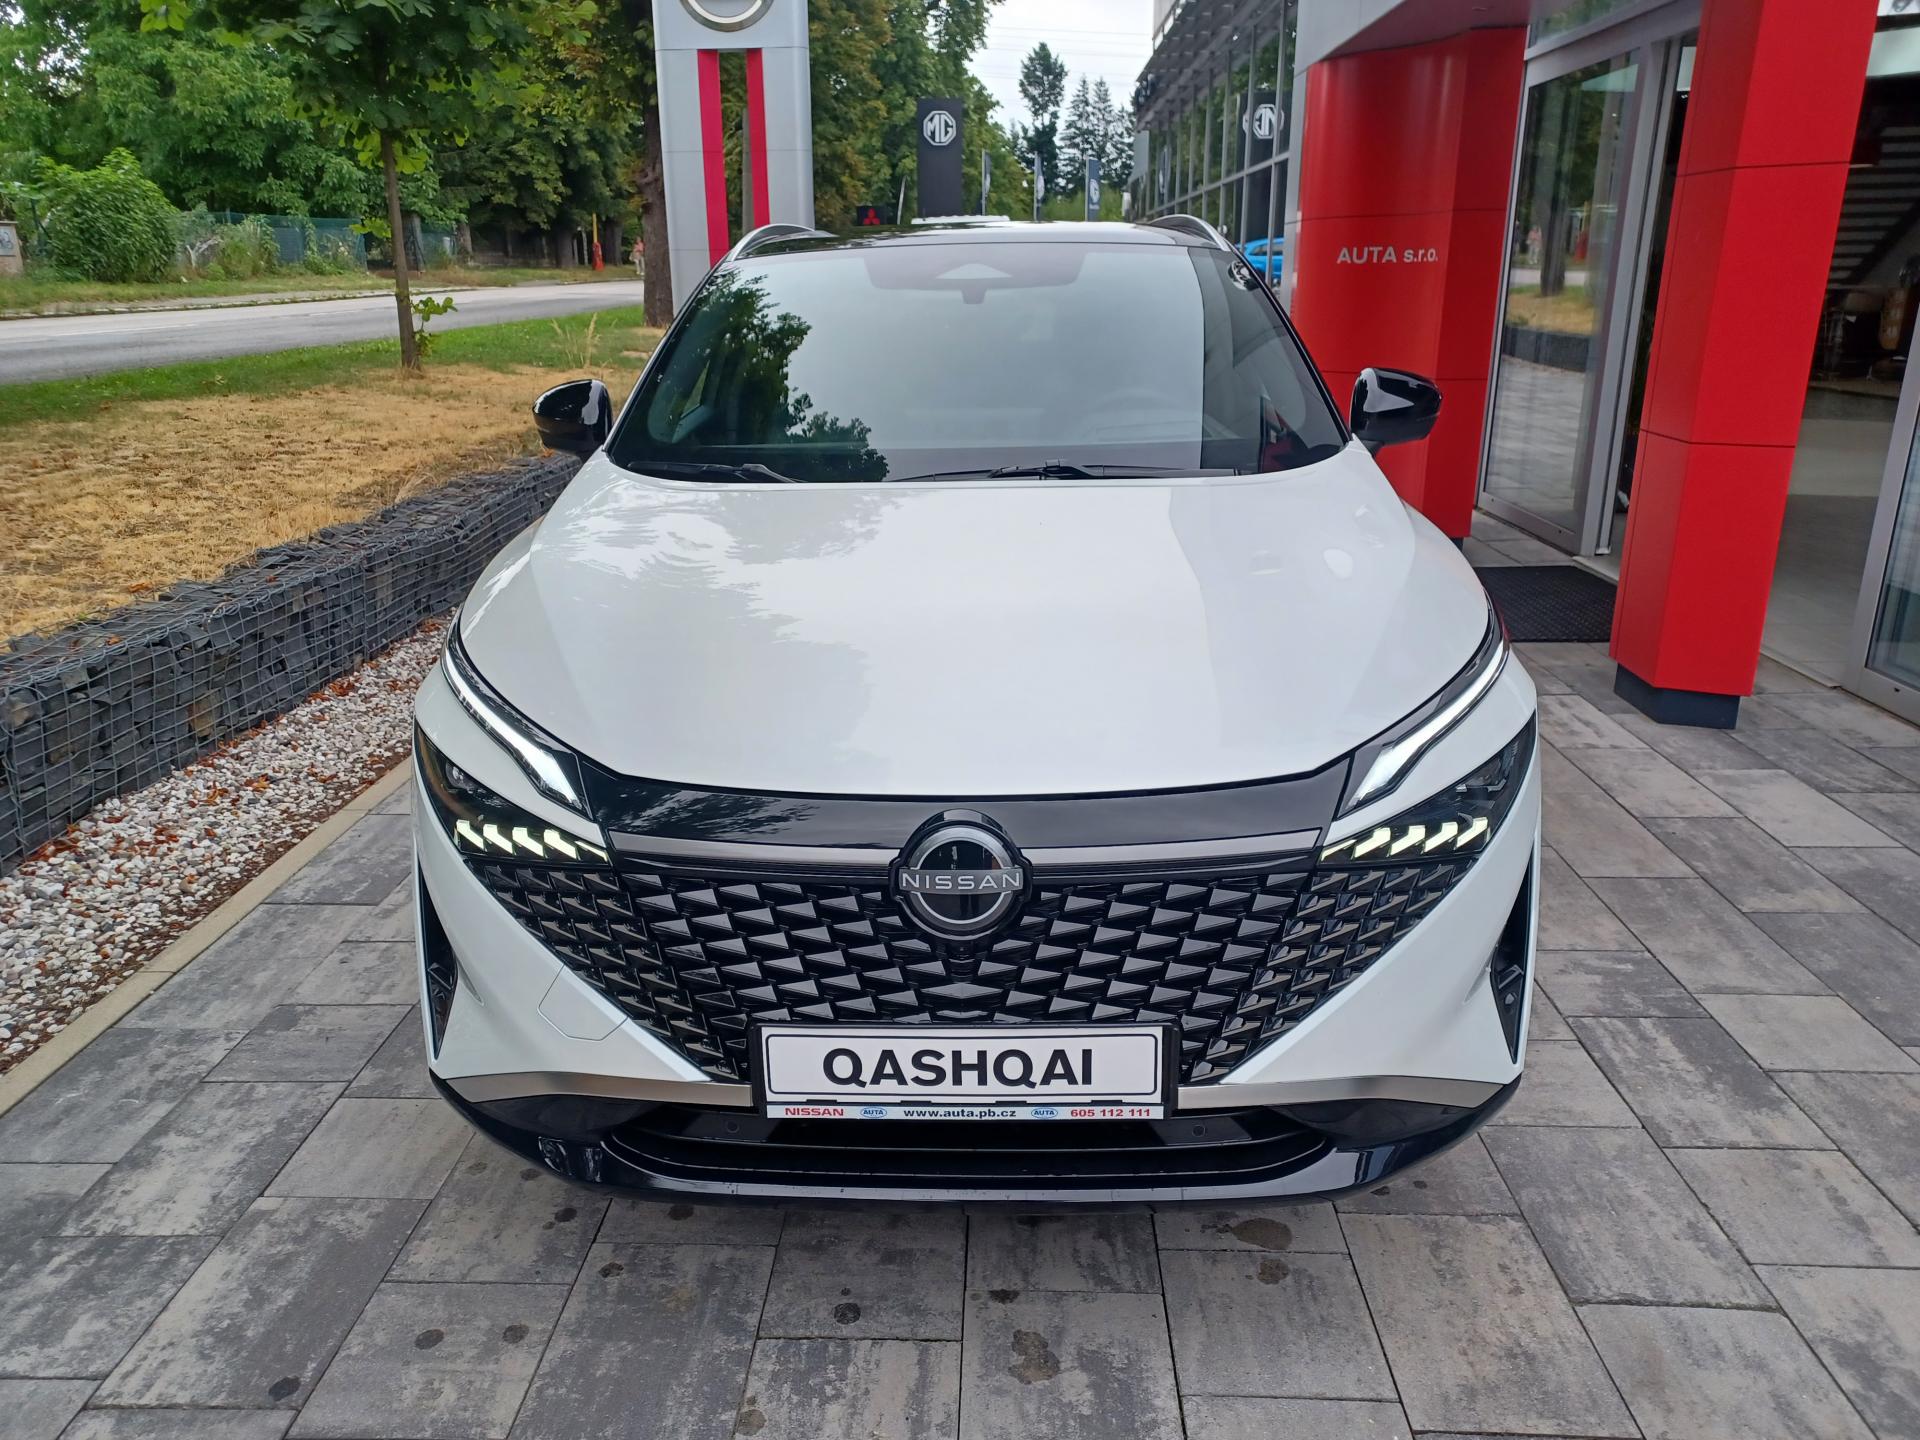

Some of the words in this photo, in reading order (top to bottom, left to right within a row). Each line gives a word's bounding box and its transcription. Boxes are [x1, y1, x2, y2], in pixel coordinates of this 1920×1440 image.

[925, 112, 955, 144] MG
[1336, 246, 1397, 264] AUTA
[1403, 248, 1439, 263] s.r.o.
[902, 872, 1020, 890] NISSAN
[822, 1047, 1093, 1089] QASHQAI
[784, 1107, 844, 1117] NISSAN
[903, 1108, 1017, 1119] www.auta.pb.cz
[1070, 1108, 1096, 1117] 605
[1101, 1108, 1124, 1117] 112
[1129, 1108, 1151, 1117] 111
